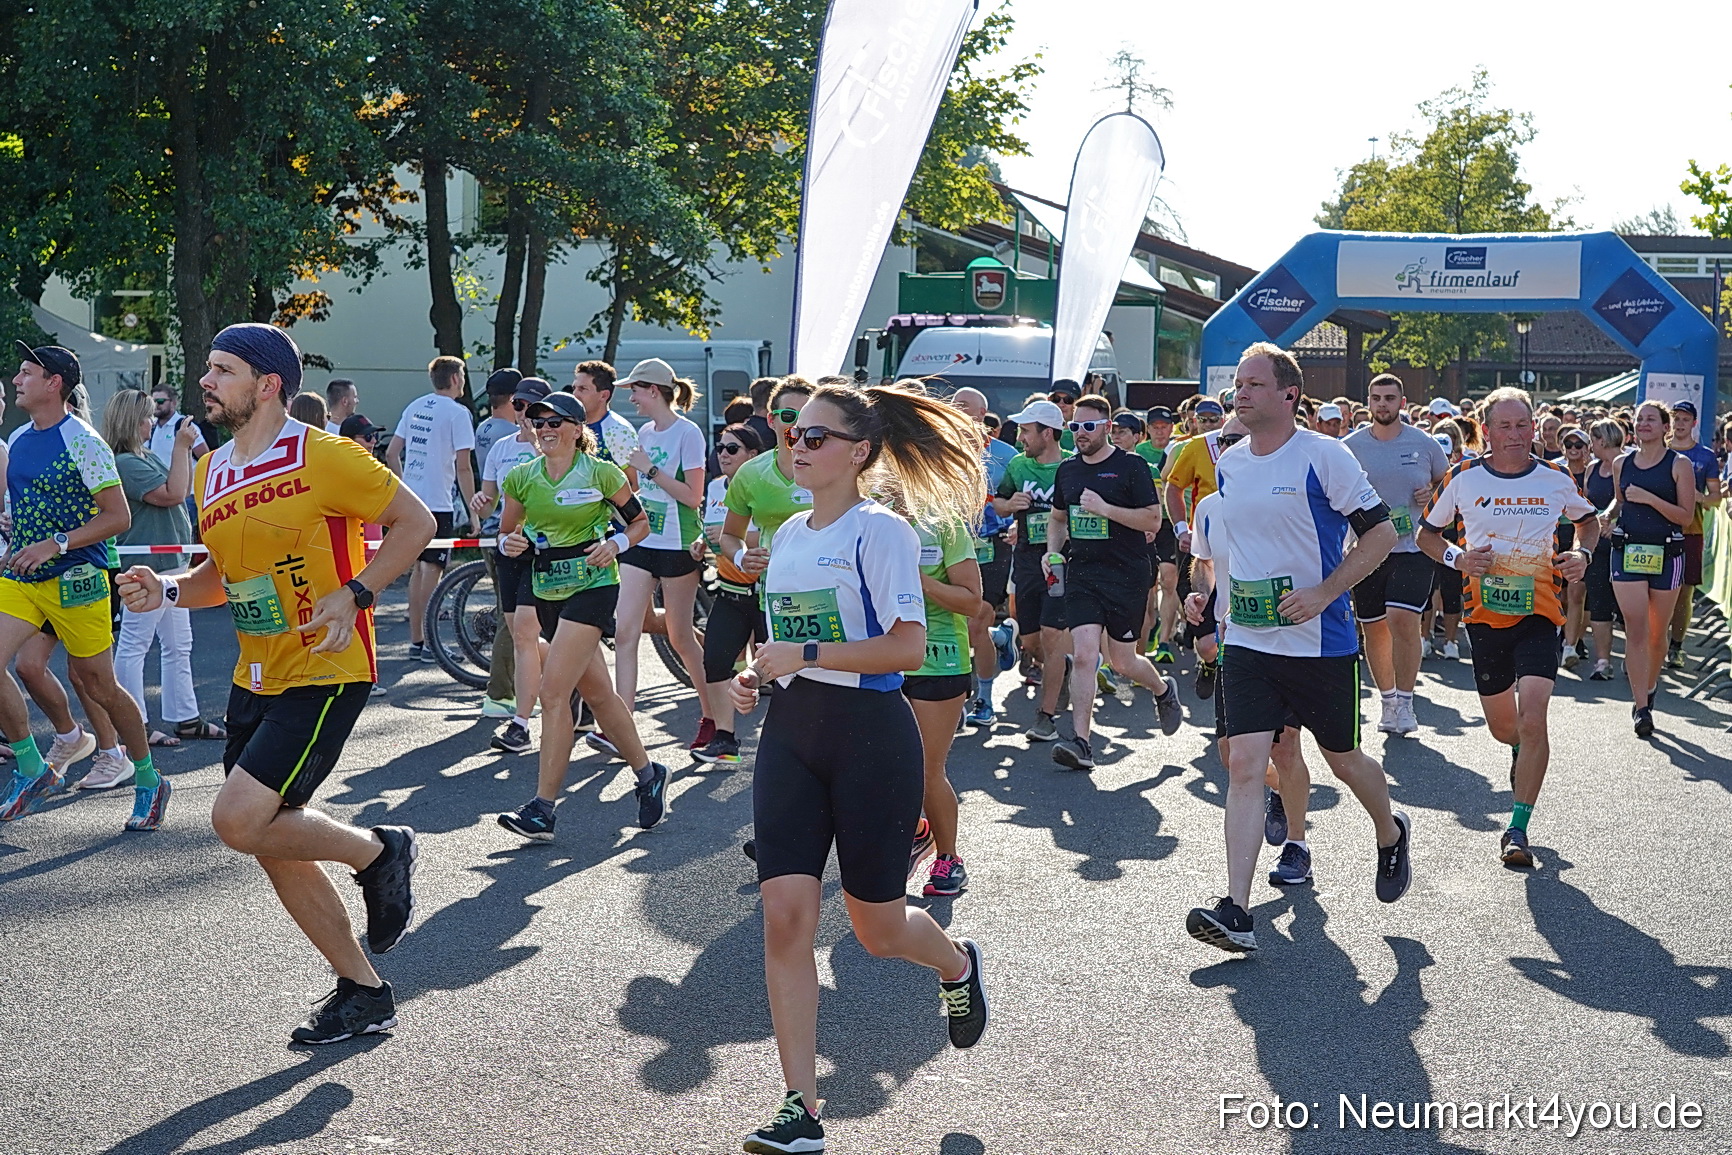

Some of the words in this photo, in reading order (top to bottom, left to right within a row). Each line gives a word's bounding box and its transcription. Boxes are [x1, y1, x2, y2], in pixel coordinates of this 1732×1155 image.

[1454, 254, 1484, 262] Fischer
[1430, 270, 1520, 287] firmenlauf
[1255, 290, 1305, 307] Fischer
[201, 499, 239, 536] MAX
[243, 477, 311, 510] BÖGL
[1495, 497, 1549, 506] KLEBL
[1493, 507, 1550, 516] DYNAMICS
[1033, 523, 1049, 534] 14
[1078, 517, 1097, 528] 775
[1633, 554, 1654, 565] 487
[73, 575, 98, 594] 687
[1233, 595, 1258, 613] 319
[1492, 589, 1520, 602] 404
[267, 598, 283, 625] 2022
[1265, 598, 1275, 620] 2022
[782, 615, 821, 638] 325
